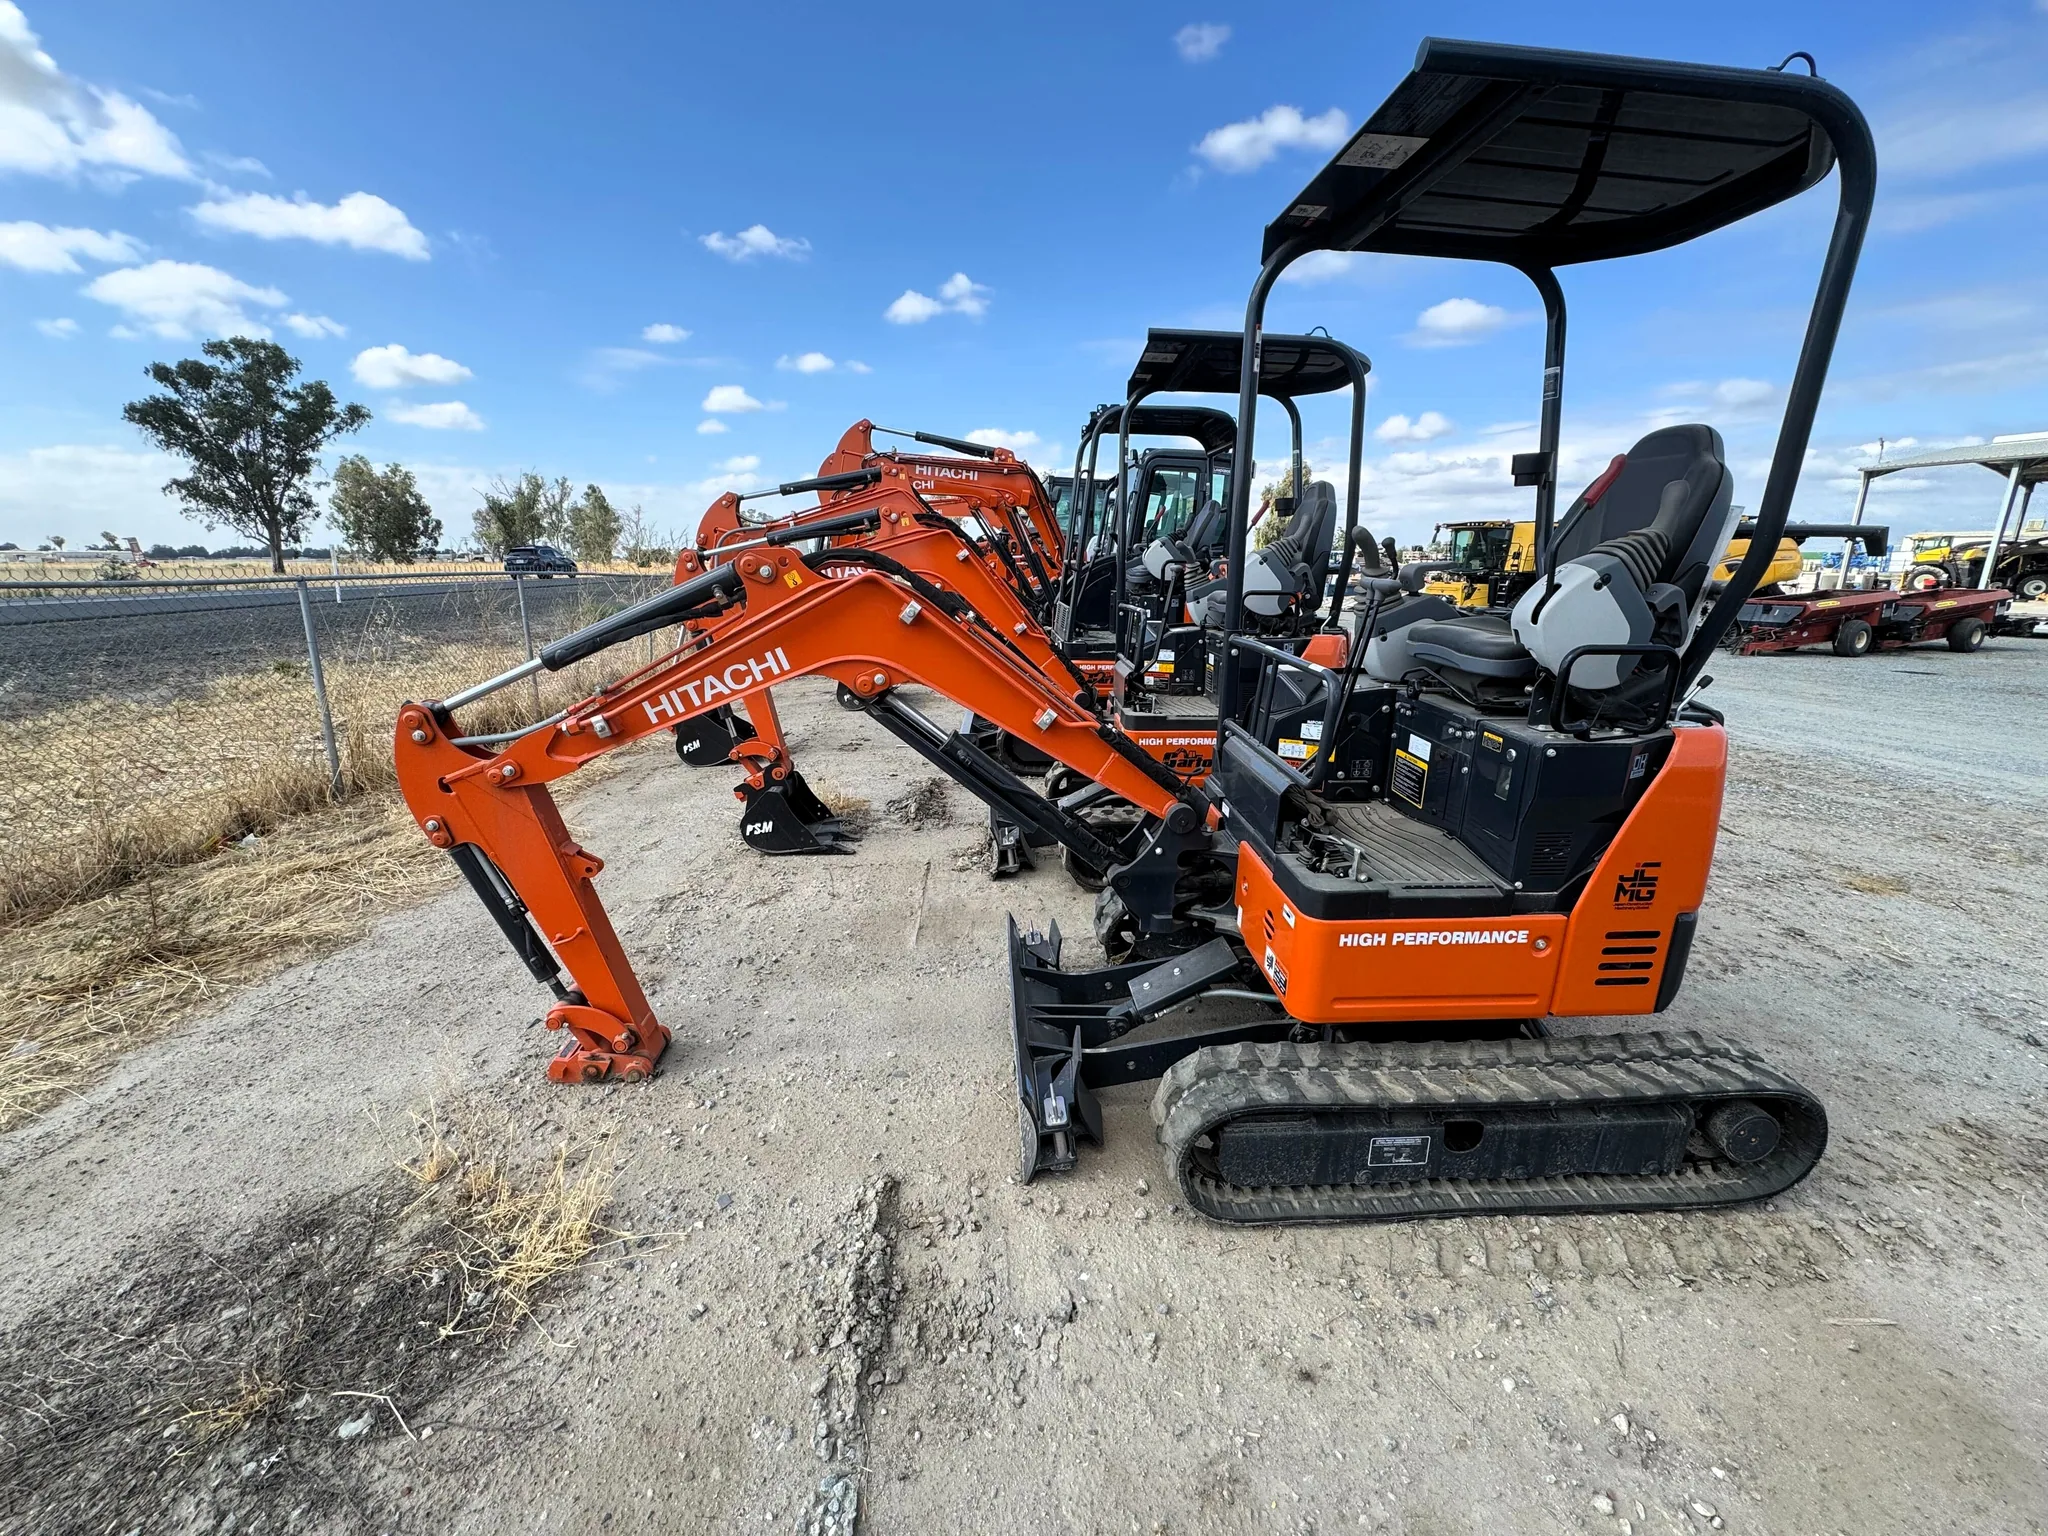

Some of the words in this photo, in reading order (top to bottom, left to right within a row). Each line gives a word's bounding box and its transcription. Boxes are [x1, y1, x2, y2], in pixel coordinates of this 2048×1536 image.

[915, 465, 978, 480] HITACHI
[912, 480, 934, 490] CHI
[641, 647, 791, 724] HITACHI
[1138, 737, 1163, 746] HIGH
[1165, 737, 1217, 746] PERFORMA
[1339, 933, 1386, 947] HIGH
[1392, 930, 1529, 946] PERFORMANCE
